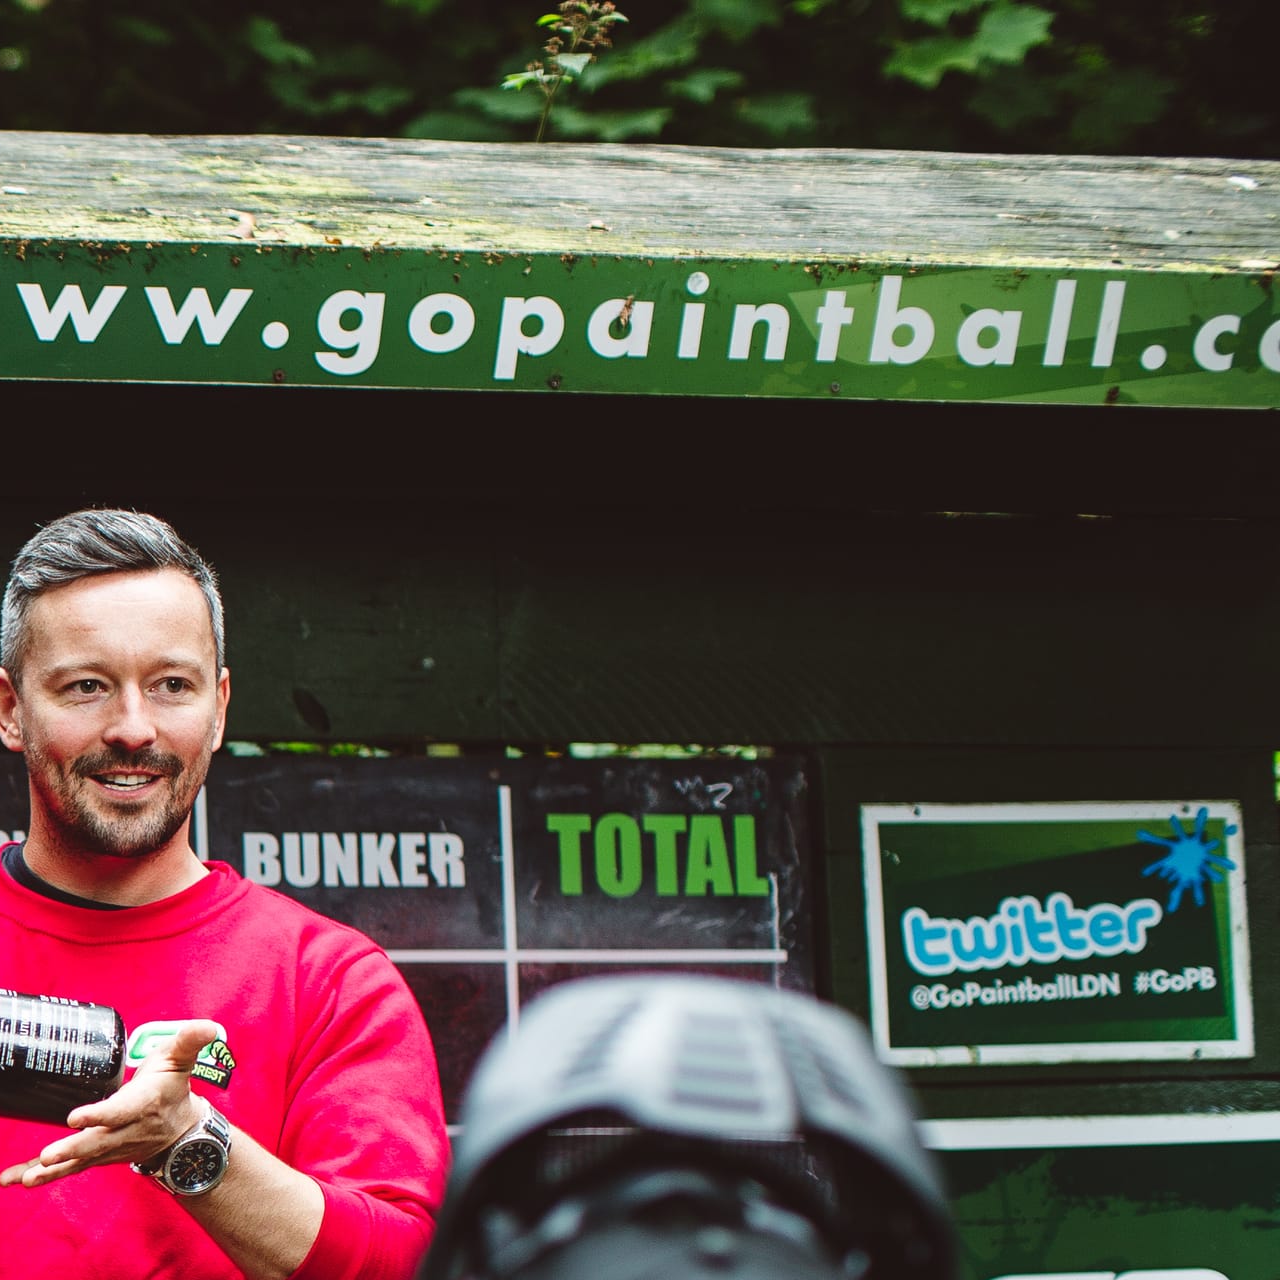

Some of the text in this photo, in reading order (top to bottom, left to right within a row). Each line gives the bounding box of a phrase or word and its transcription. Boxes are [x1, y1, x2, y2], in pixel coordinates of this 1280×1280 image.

[241, 831, 466, 889] BUNKER
[546, 812, 770, 898] TOTAL
[906, 895, 1160, 972] twitter
[911, 966, 1217, 1010] @GoPaintballLDN #GoPB
